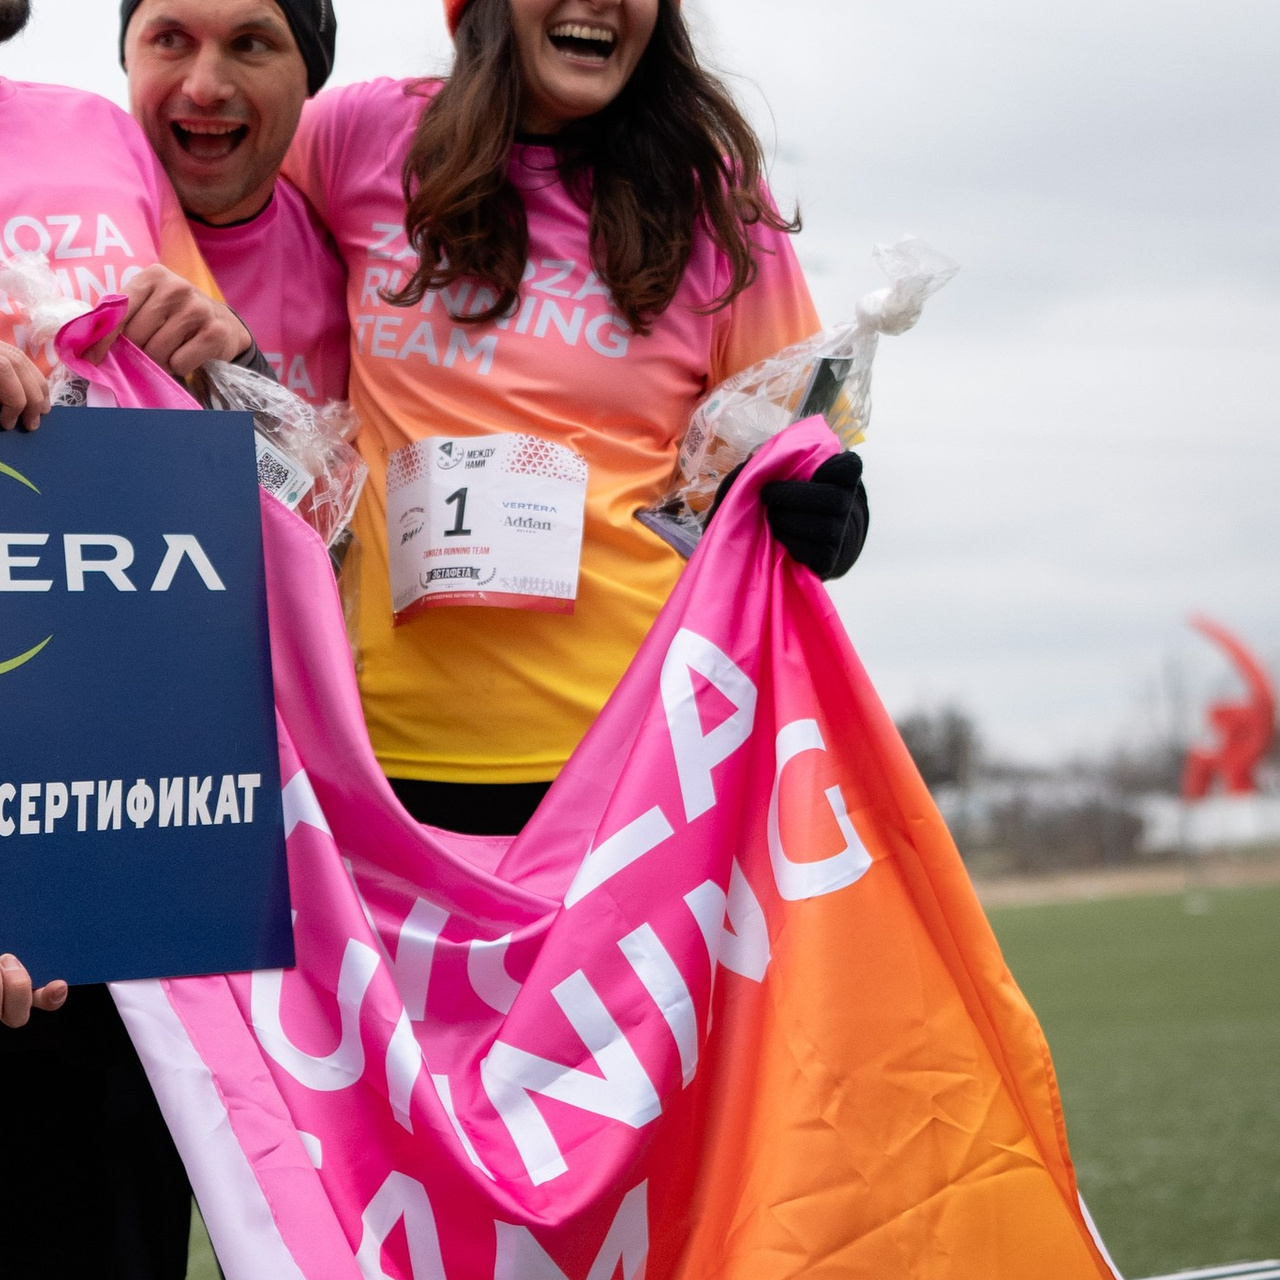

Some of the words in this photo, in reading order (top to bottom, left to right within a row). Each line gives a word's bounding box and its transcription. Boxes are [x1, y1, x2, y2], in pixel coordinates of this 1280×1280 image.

[355, 314, 498, 376] TEAM
[466, 448, 495, 459] МЕЖДУ
[465, 459, 486, 469] НАМИ
[444, 487, 472, 537] 1
[502, 502, 557, 513] VERTERA
[503, 516, 551, 531] Adrian
[472, 546, 490, 555] TEAM
[431, 567, 471, 579] ЭСТАФЕТА
